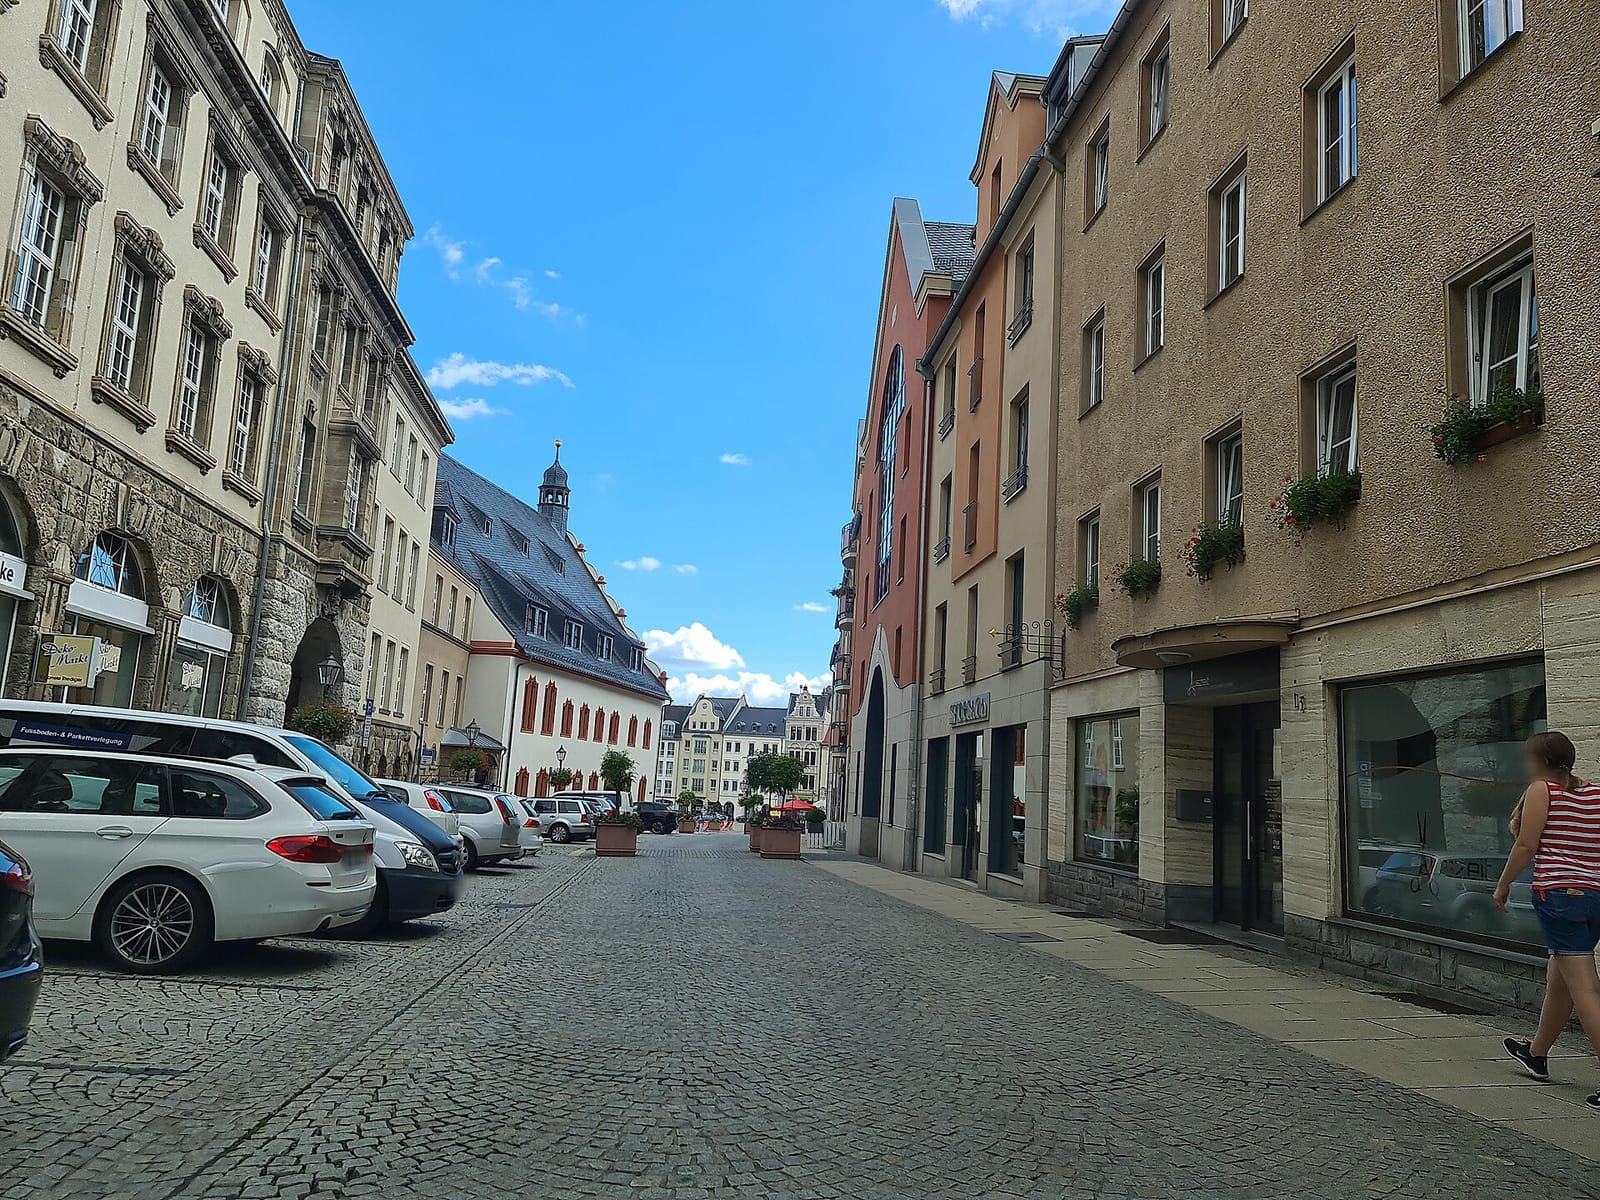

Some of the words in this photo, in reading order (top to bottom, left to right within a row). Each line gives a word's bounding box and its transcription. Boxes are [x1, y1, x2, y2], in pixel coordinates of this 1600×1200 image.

[0, 561, 14, 582] ke
[49, 654, 88, 668] Markt
[20, 726, 60, 737] Fussboden-
[67, 733, 123, 746] Parkettverlegung
